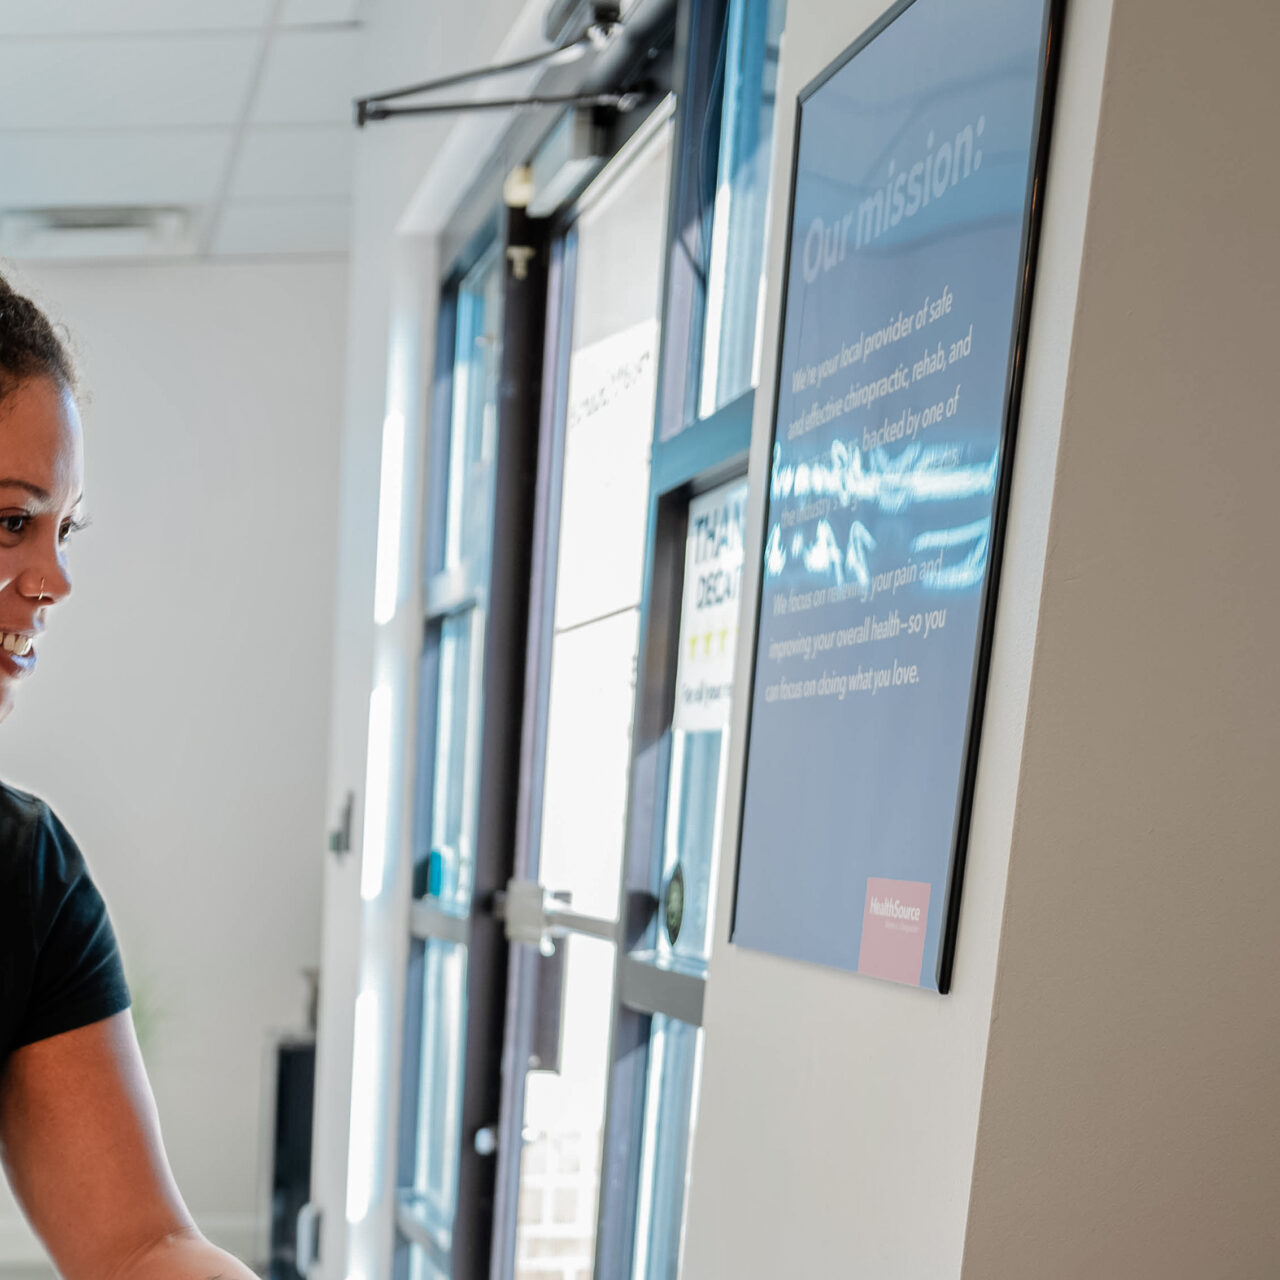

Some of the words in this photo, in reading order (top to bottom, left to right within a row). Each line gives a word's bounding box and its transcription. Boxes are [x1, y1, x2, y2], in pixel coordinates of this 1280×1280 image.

[803, 210, 854, 284] Our
[856, 115, 986, 250] mission:
[792, 364, 816, 393] We're
[817, 353, 840, 388] your
[840, 331, 864, 368] local
[864, 311, 914, 363] provider
[915, 296, 929, 330] of
[929, 285, 952, 322] safe
[787, 409, 804, 440] and
[805, 396, 843, 433] effective
[844, 363, 909, 413] chiropractic,
[912, 341, 947, 382] rehab,
[948, 324, 973, 364] and
[862, 409, 904, 451] backed
[905, 407, 920, 440] by
[922, 403, 944, 428] one
[946, 384, 961, 418] of
[773, 594, 787, 616] We
[788, 588, 811, 612] focus
[812, 589, 826, 608] on
[870, 571, 893, 600] your
[892, 558, 917, 595] pain
[920, 549, 943, 579] and
[768, 632, 812, 663] improving
[812, 630, 836, 660] your
[836, 616, 870, 648] overall
[923, 607, 947, 639] you
[780, 675, 802, 700] focus
[803, 681, 816, 699] on
[817, 669, 847, 701] doing
[848, 663, 872, 692] what
[872, 667, 891, 696] you
[892, 658, 920, 686] love.
[869, 895, 922, 922] HealthSource
